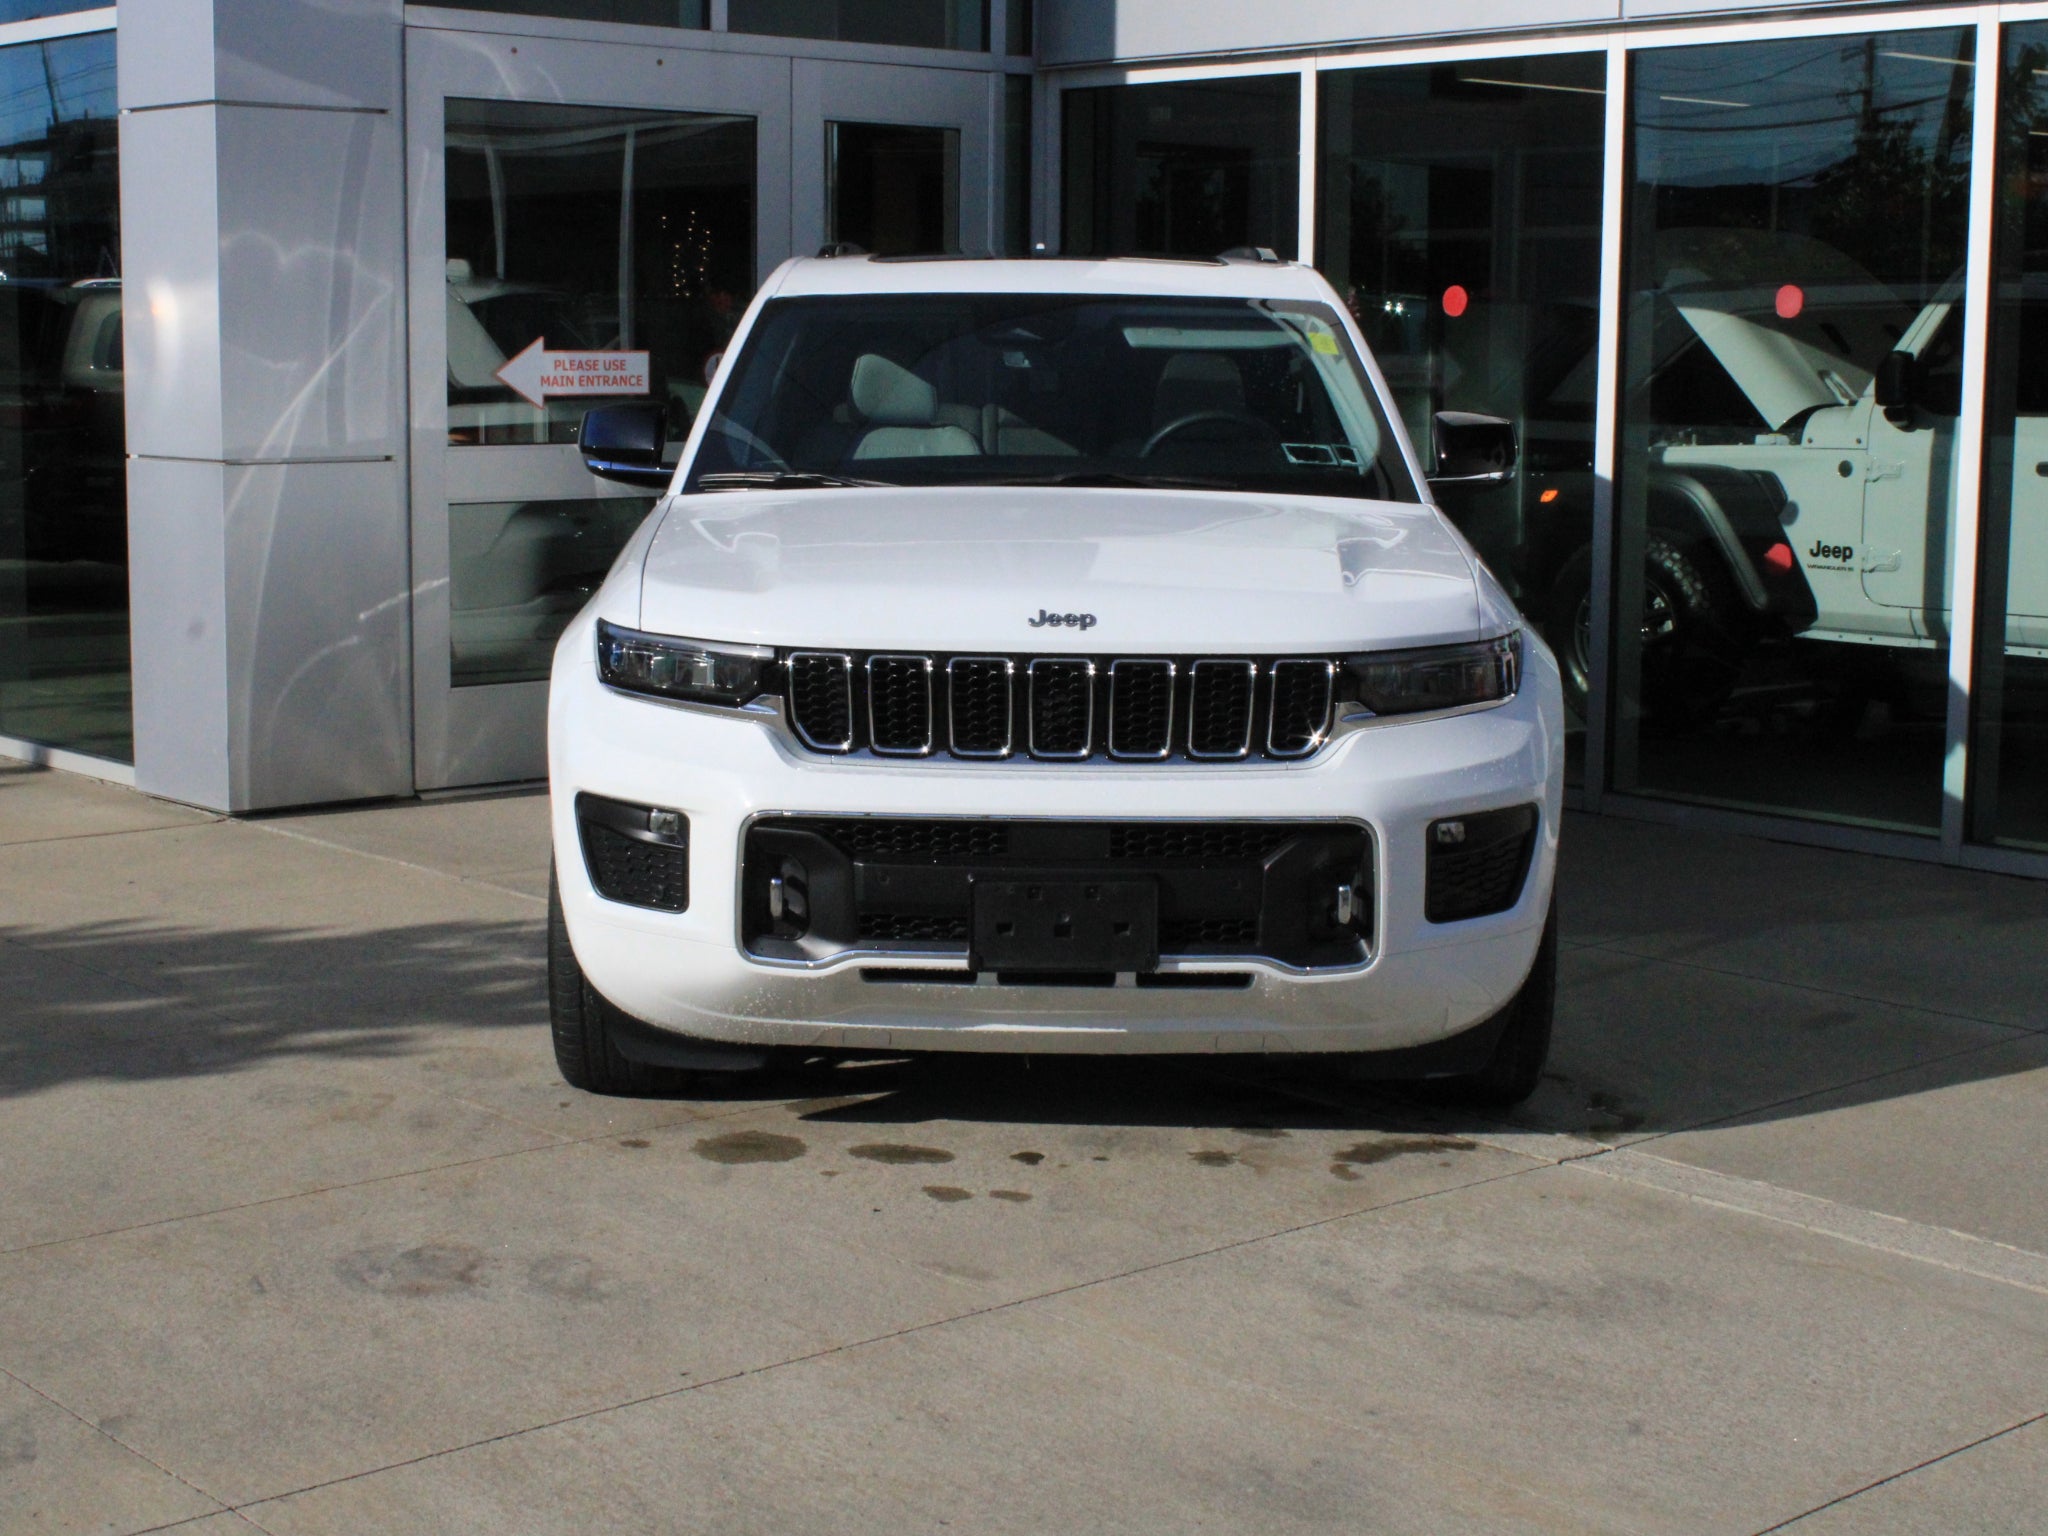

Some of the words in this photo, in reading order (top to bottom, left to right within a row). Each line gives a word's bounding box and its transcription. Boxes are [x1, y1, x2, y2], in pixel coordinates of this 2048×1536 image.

[554, 359, 599, 371] PLEASE
[603, 359, 626, 371] USE
[540, 375, 575, 387] MAIN
[578, 375, 643, 387] ENTRANCE
[1809, 540, 1853, 563] Jeep
[1028, 609, 1097, 631] Jeep
